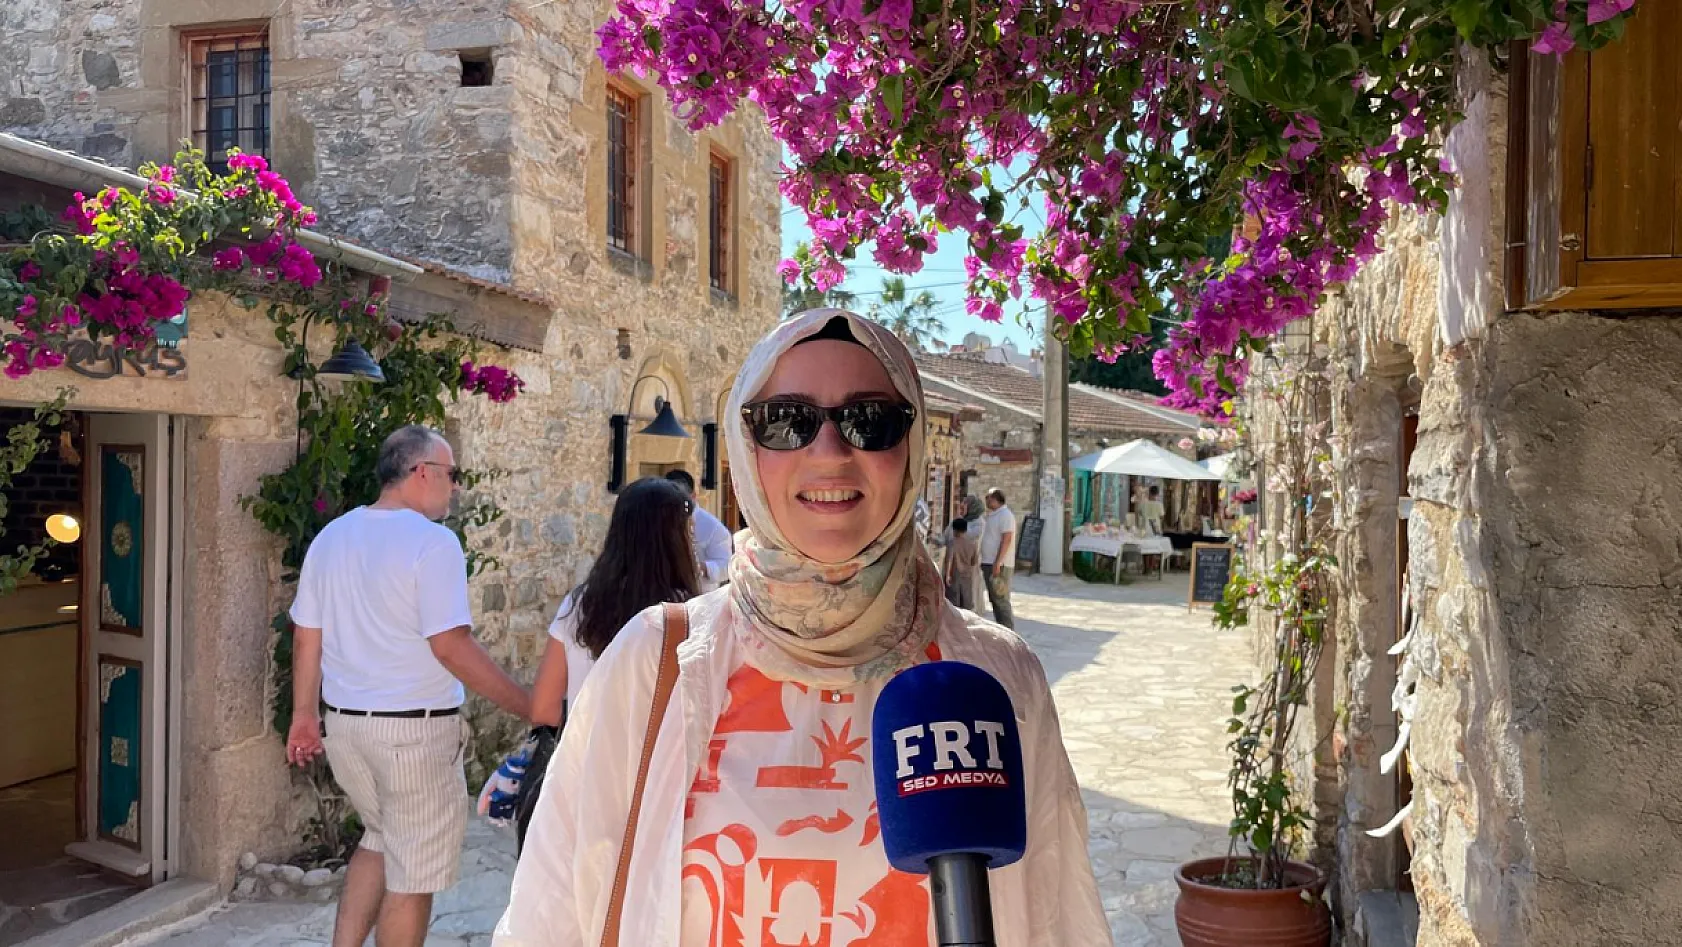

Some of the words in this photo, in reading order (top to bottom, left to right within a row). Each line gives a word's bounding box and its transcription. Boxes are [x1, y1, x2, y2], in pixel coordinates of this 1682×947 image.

[893, 721, 1004, 778] FRT
[903, 776, 938, 791] SED
[944, 773, 1005, 784] MEDYA
